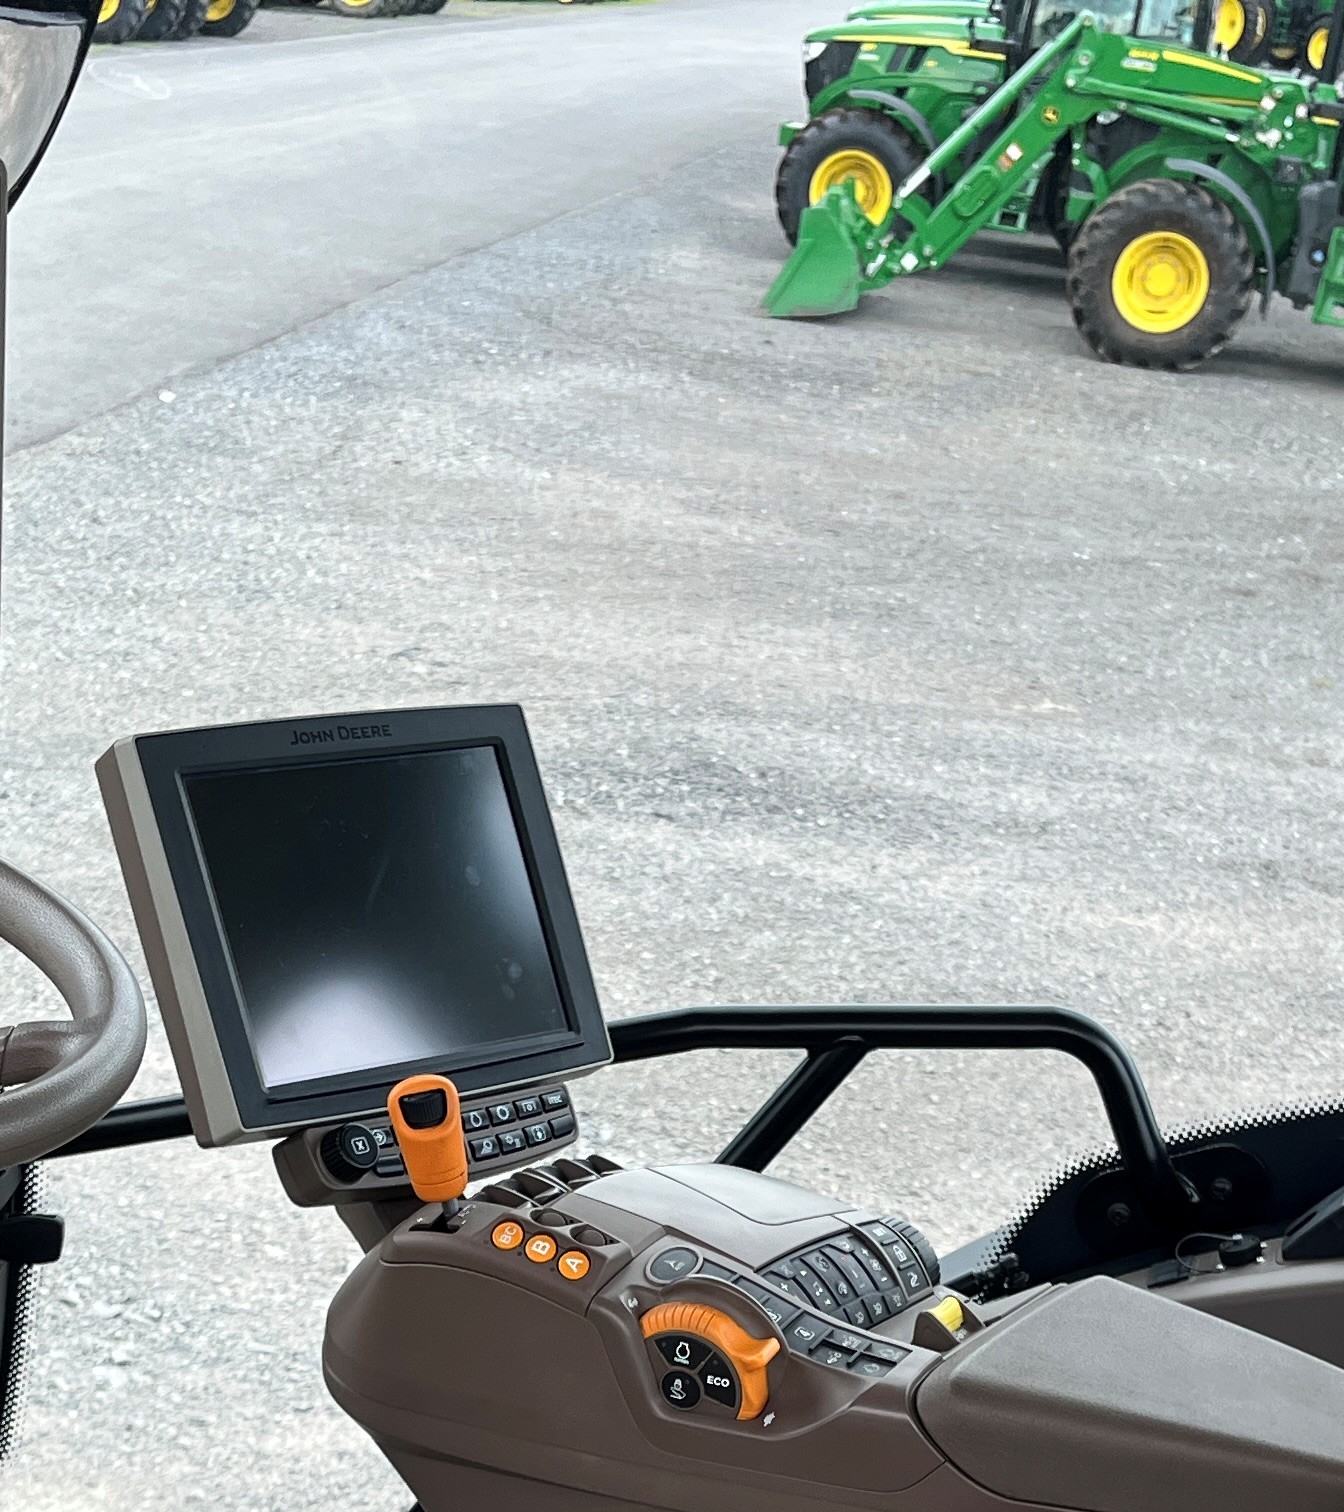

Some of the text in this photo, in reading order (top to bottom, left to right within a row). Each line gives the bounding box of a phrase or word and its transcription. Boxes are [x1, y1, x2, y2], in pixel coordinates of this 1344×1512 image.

[290, 725, 392, 745] JOHN DEERE
[499, 1226, 518, 1245] BC
[531, 1240, 551, 1256] B
[565, 1258, 585, 1274] A
[706, 1375, 730, 1388] ECO
